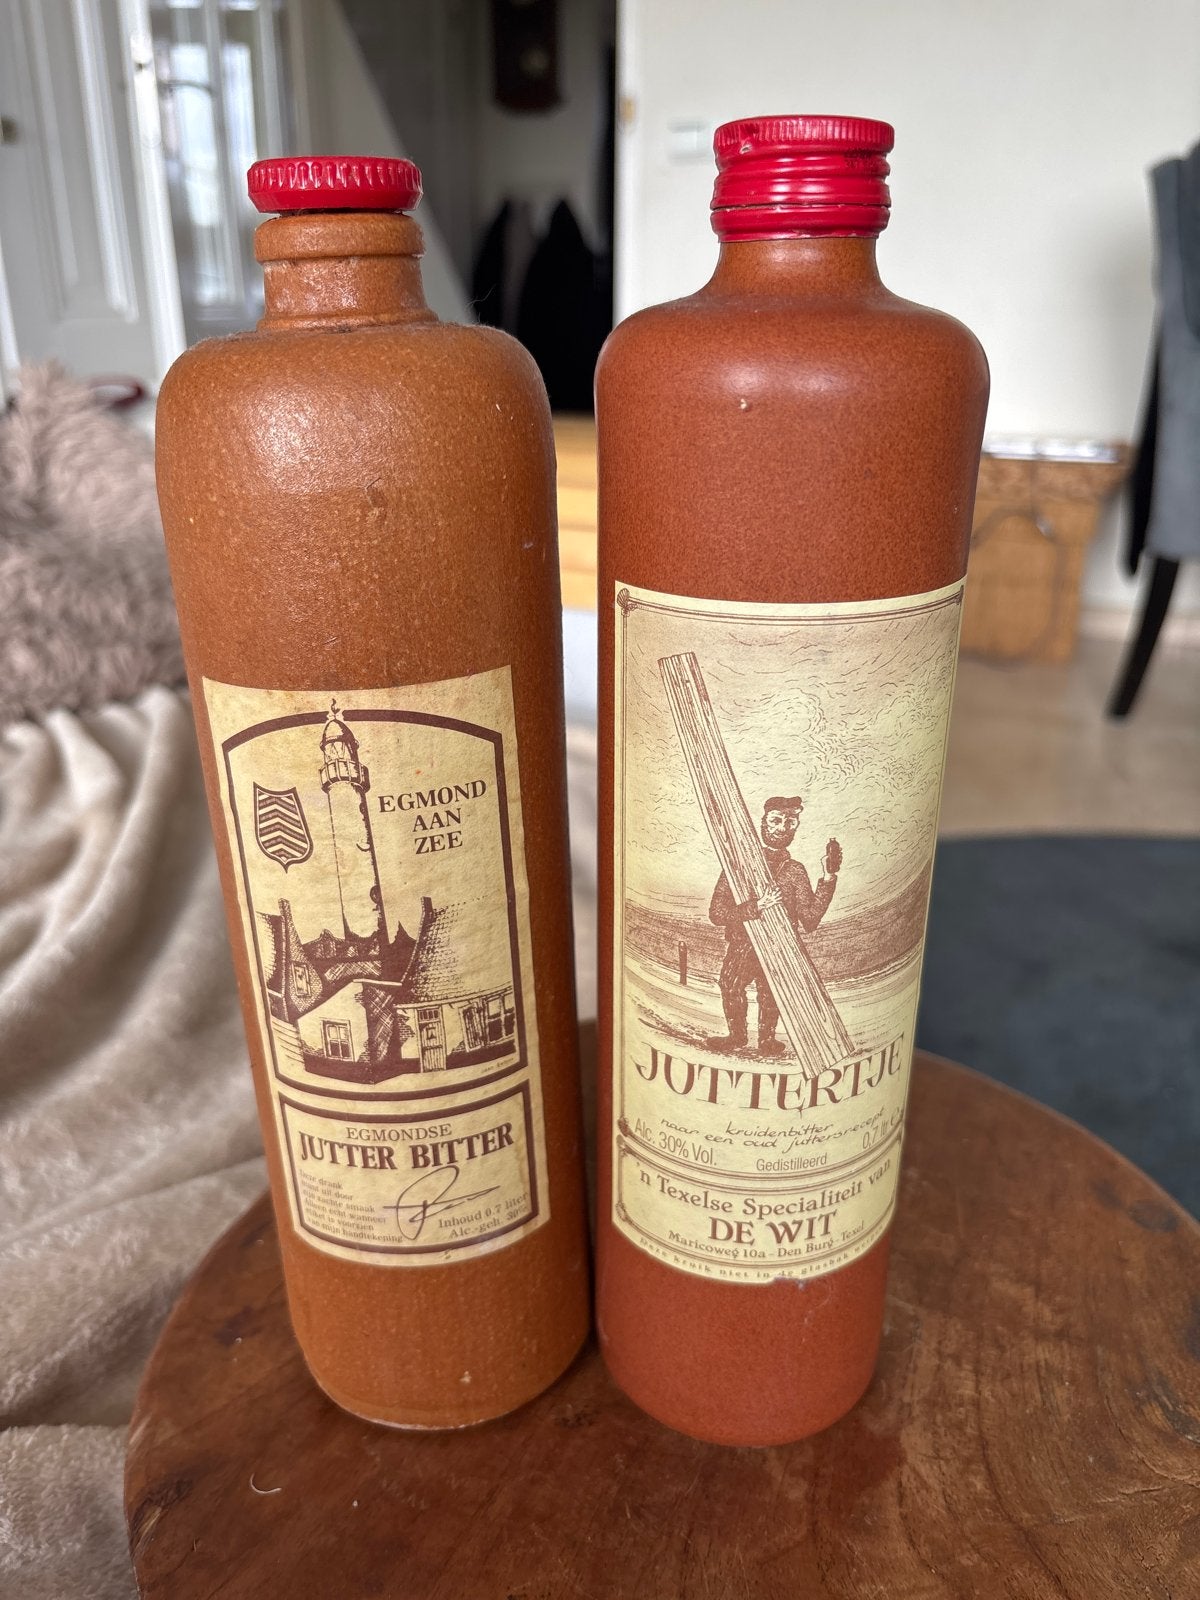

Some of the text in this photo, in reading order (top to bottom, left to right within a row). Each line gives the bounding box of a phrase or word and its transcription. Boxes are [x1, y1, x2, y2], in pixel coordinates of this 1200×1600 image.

[378, 779, 487, 813] EGMOND
[412, 808, 462, 832] AAN
[414, 830, 463, 855] ZEE
[633, 1032, 904, 1116] JUTTERTJE
[298, 1122, 514, 1170] JUTTER BITTER
[345, 1123, 453, 1142] EGMONDSE
[635, 1118, 717, 1166] Alc. 30% Vol.
[660, 1119, 699, 1134] naar
[704, 1134, 734, 1145] een
[743, 1139, 778, 1148] oud
[725, 1121, 834, 1138] kruidenbitter
[756, 1152, 827, 1172] Gedistilleerd
[657, 1175, 733, 1213] Texelse
[743, 1181, 862, 1220] Specialiteit
[869, 1159, 890, 1185] van
[438, 1210, 482, 1228] Inhoud
[504, 1192, 528, 1210] liter
[708, 1209, 838, 1246] DE WIT
[668, 1230, 739, 1258] Maricoweg
[743, 1248, 766, 1258] 10a
[777, 1247, 802, 1257] Den
[805, 1239, 834, 1254] Burg
[840, 1220, 865, 1241] Texel
